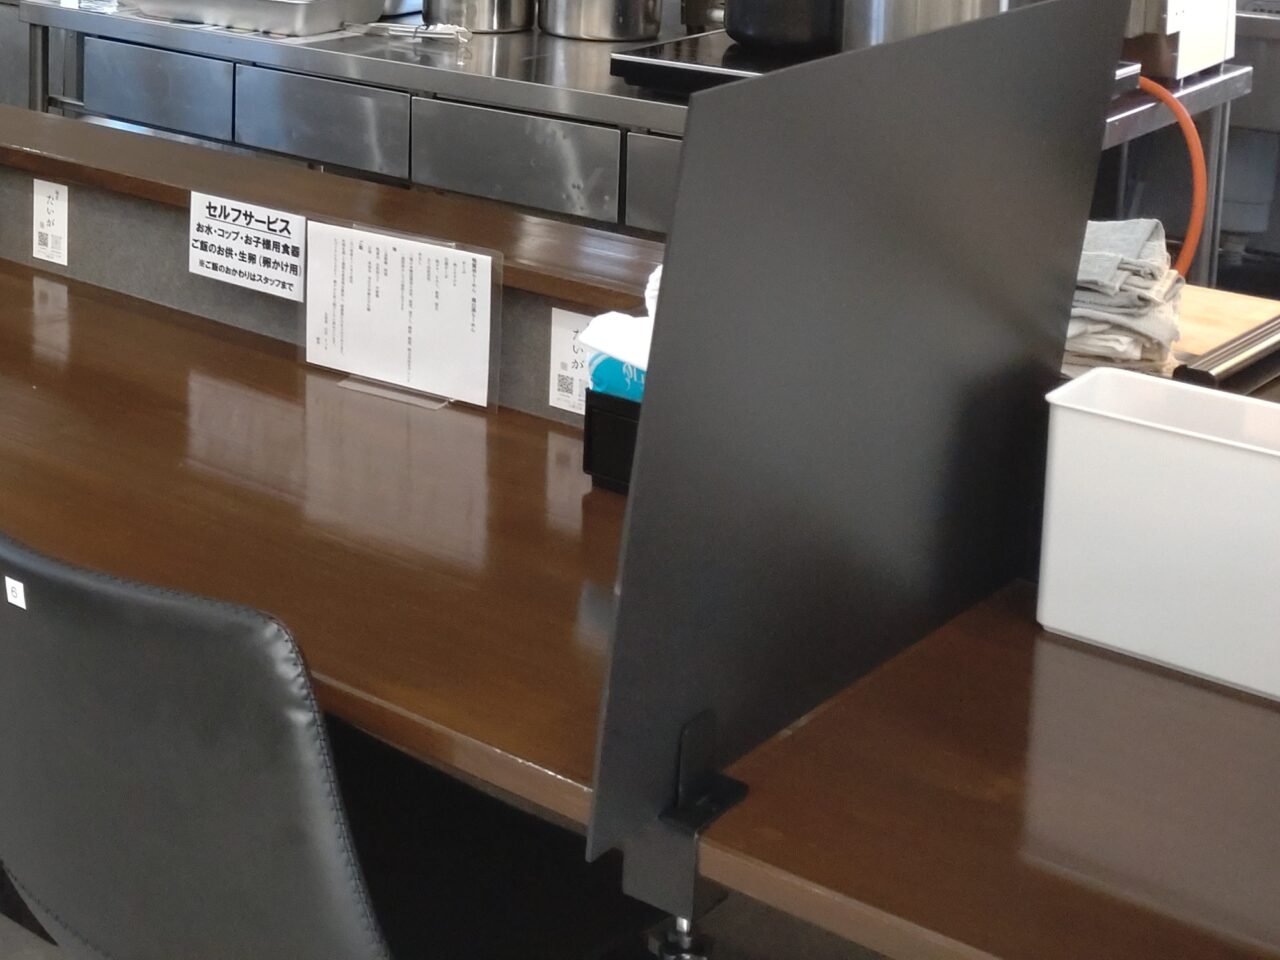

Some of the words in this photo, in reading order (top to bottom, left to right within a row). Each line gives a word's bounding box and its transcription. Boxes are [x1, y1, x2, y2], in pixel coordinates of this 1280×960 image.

[205, 201, 292, 236] セルフサービス
[195, 222, 301, 259] お水・コップ・お子様用食器
